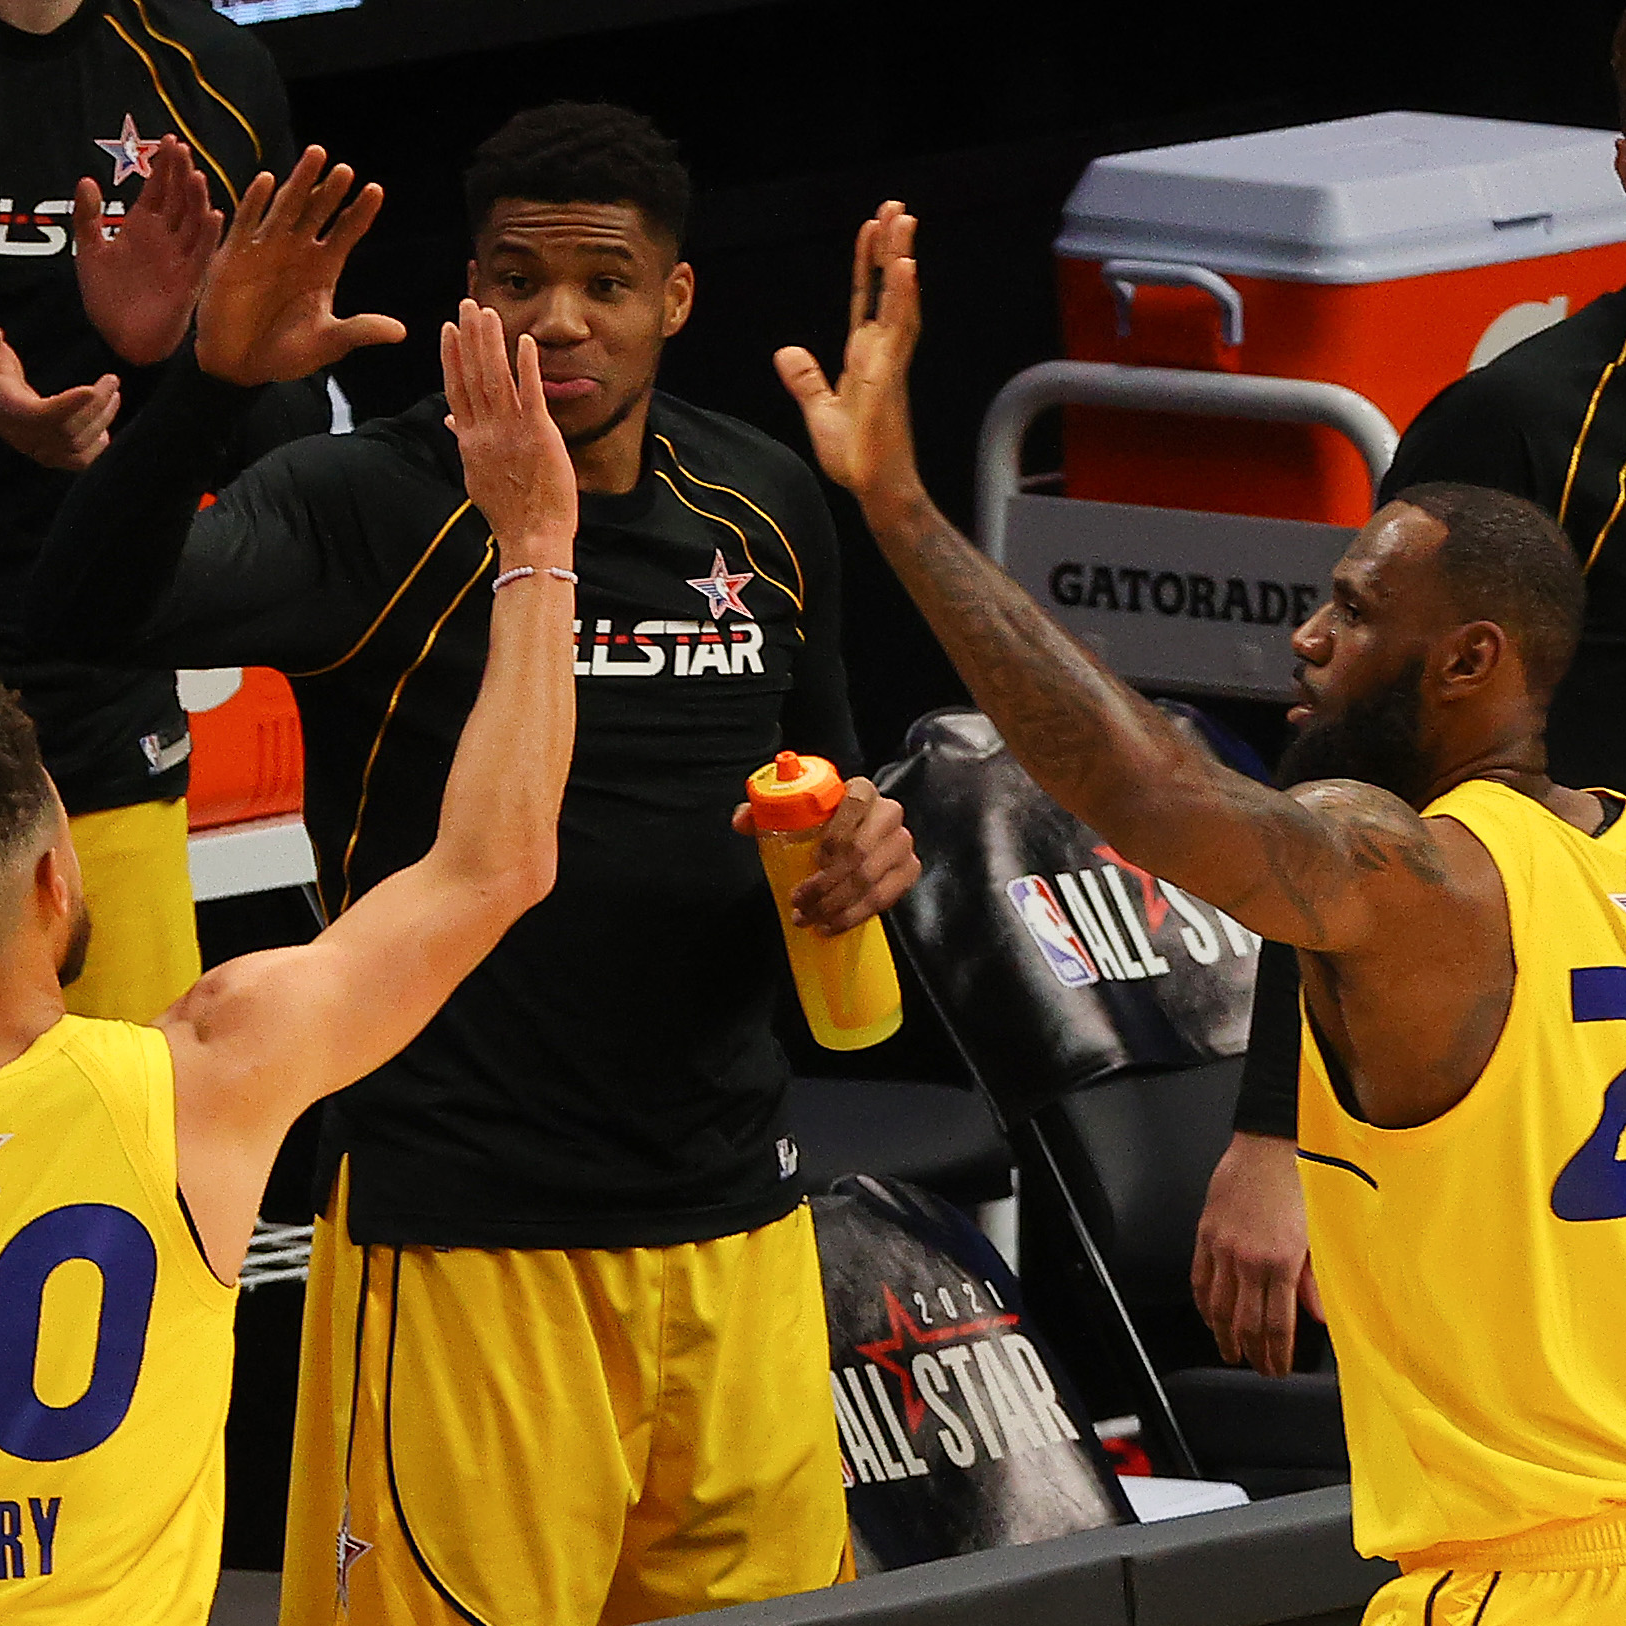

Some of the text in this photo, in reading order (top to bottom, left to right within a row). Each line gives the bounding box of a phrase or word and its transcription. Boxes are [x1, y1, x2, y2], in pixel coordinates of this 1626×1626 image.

[1048, 562, 1319, 627] GATORADE
[1054, 863, 1171, 981] ALL
[913, 1280, 1005, 1324] 2021
[830, 1333, 1080, 1484] ALL STAR
